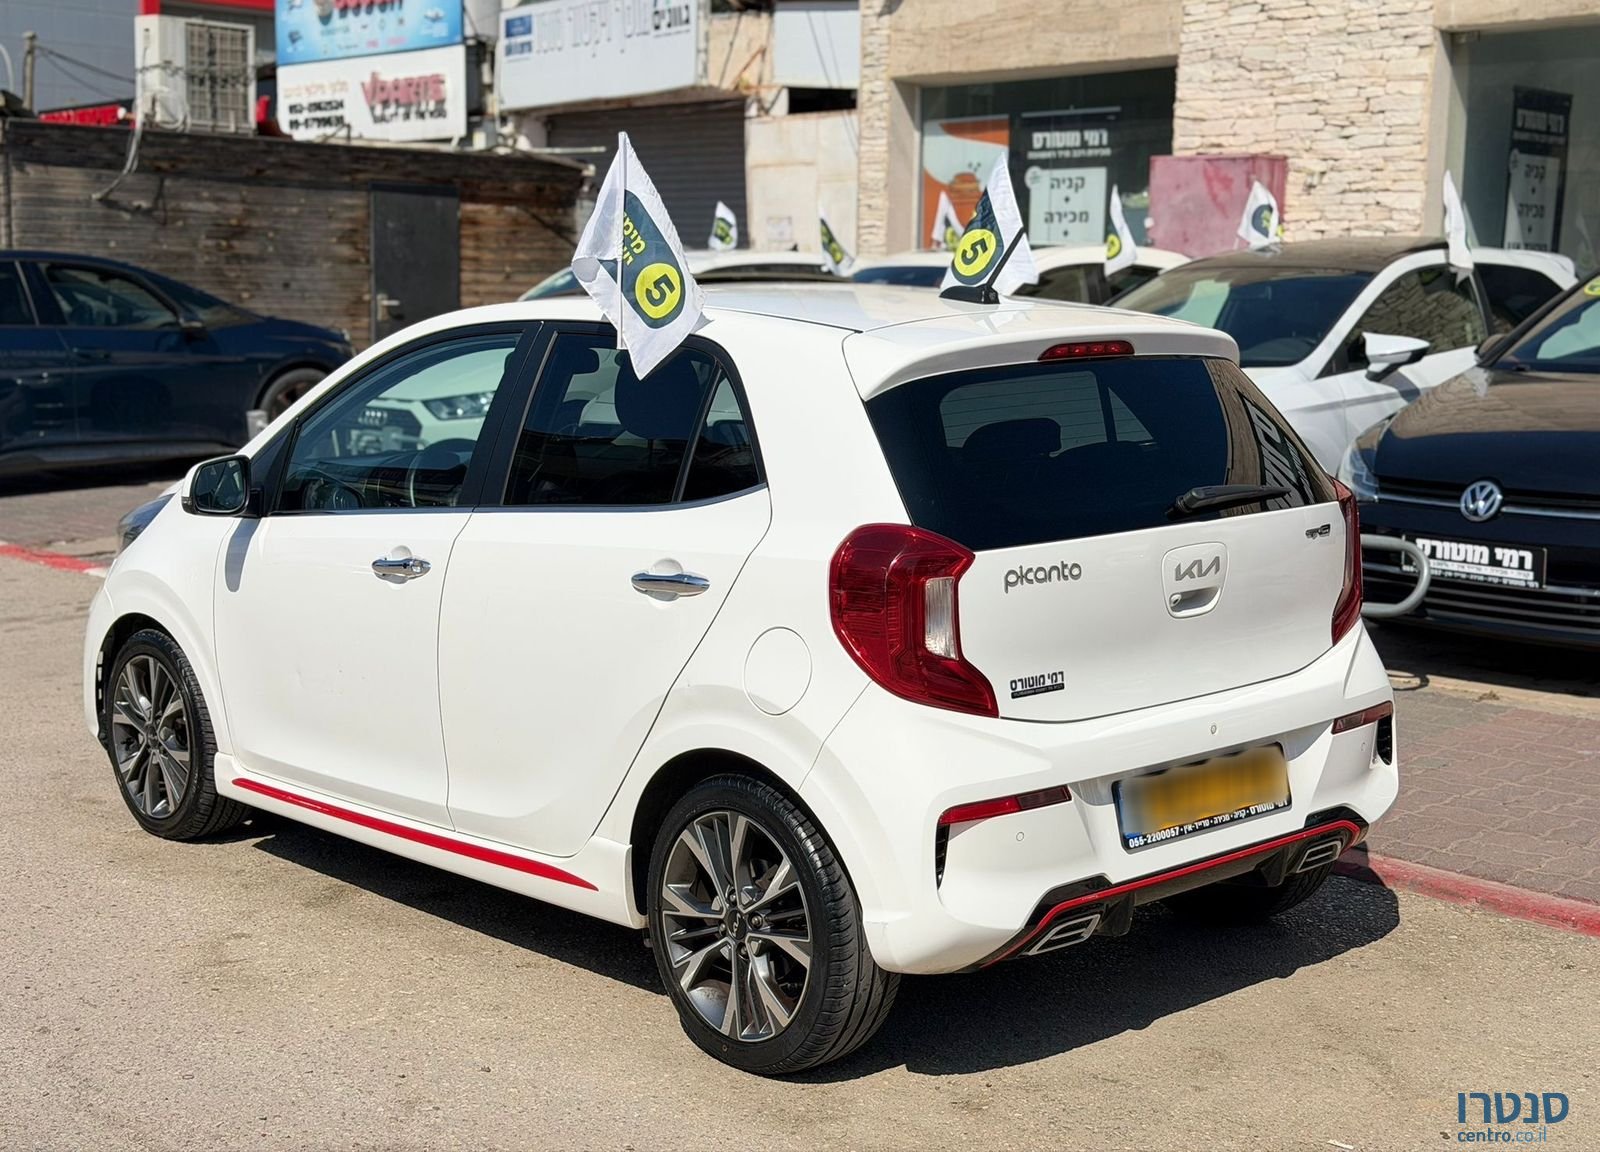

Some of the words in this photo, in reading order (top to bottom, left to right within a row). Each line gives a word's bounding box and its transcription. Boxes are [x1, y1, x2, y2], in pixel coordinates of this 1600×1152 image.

[1032, 130, 1081, 149] מוטורס
[1083, 129, 1108, 147] רמי
[1050, 176, 1085, 193] קניה
[1044, 211, 1090, 223] מכירה
[961, 238, 988, 265] 5
[645, 273, 675, 307] 5
[1175, 556, 1220, 581] KIA
[1494, 547, 1533, 570] רמי
[1004, 560, 1082, 593] picanto
[1010, 674, 1046, 692] מוטורס
[1047, 670, 1065, 684] רמי
[1128, 826, 1180, 849] 055-2200057
